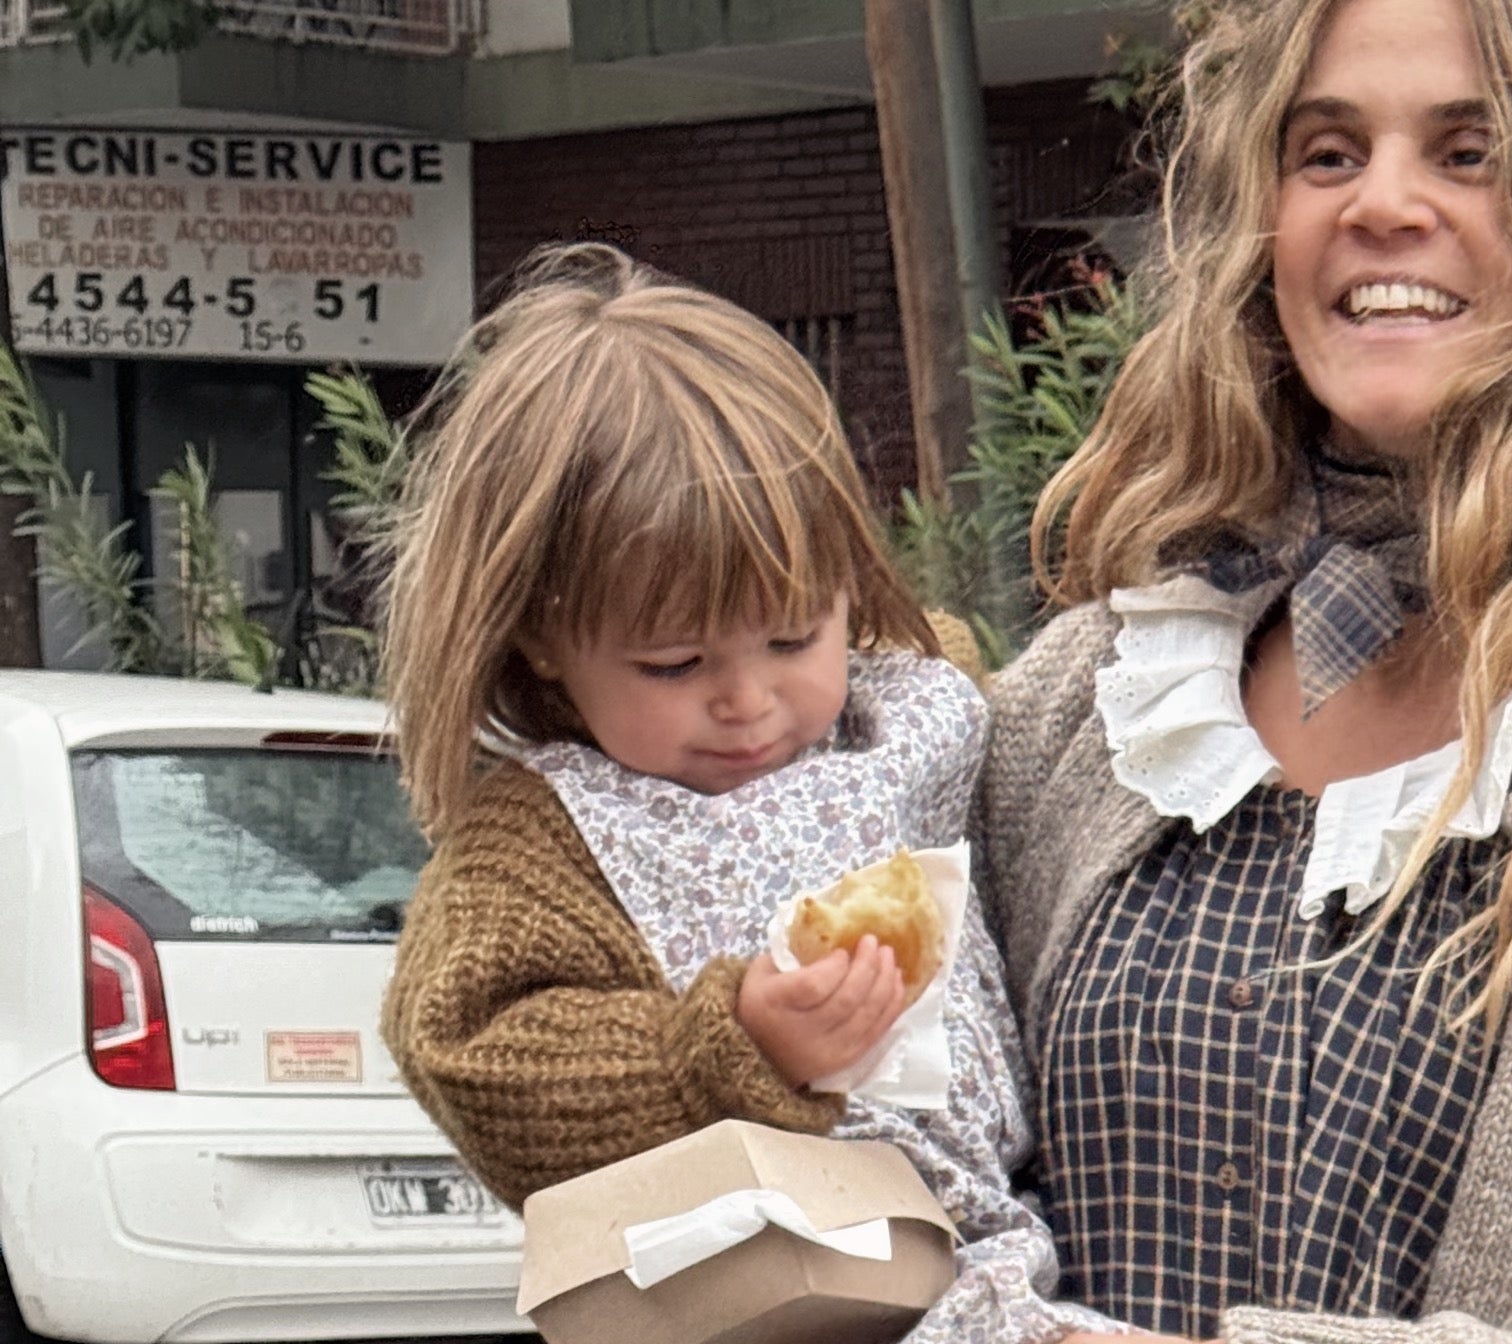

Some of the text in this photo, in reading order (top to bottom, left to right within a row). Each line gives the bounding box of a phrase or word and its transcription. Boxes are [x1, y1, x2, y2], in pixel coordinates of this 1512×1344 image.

[19, 183, 414, 219] REPARACION E INSTALACION
[38, 215, 398, 249] DE AIRE ACONDICIONADO
[10, 241, 424, 279] HELADERAS Y LAVARROPAS
